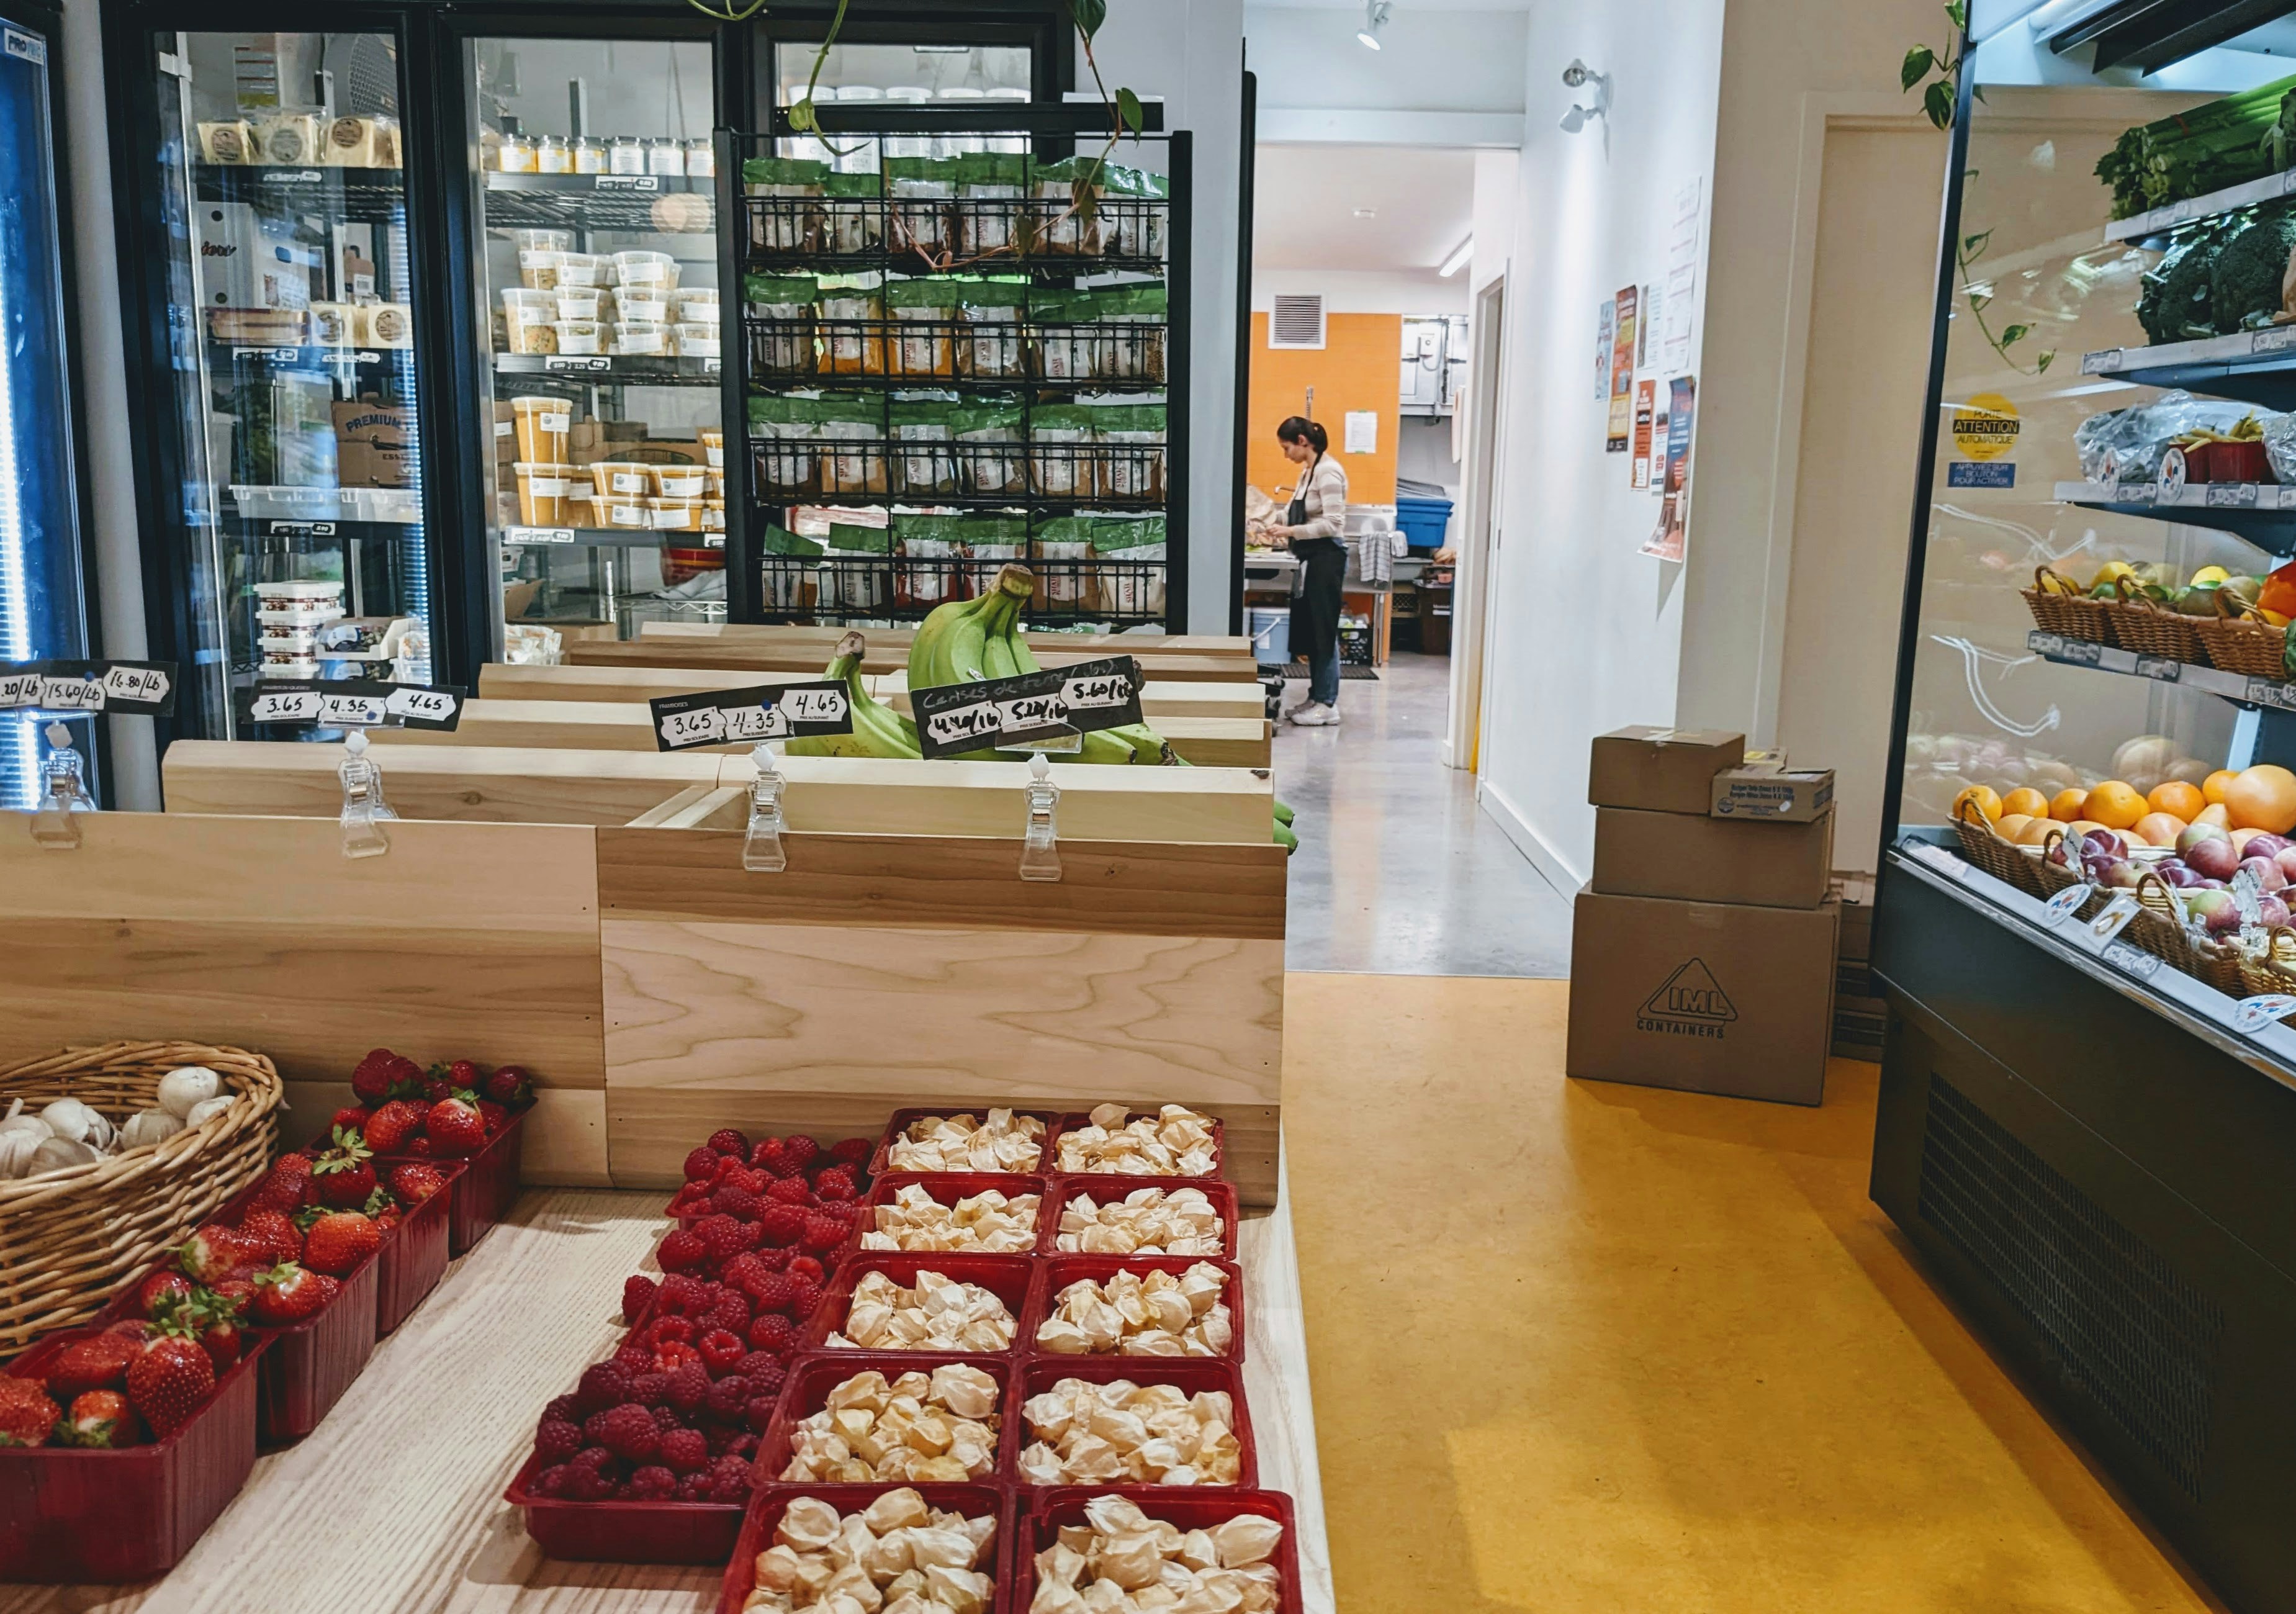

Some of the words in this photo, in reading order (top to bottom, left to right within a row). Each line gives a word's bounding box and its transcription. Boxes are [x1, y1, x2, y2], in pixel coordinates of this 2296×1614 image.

[346, 414, 400, 432] PREMIUM
[1955, 421, 2017, 433] ATTENTION
[1957, 435, 2013, 444] AUTOMATIQUE
[267, 697, 303, 713] 3.65
[330, 699, 369, 713] 4.35
[408, 694, 443, 710] 4.65
[796, 694, 838, 715] 4.65
[674, 713, 712, 735] 3.65
[733, 711, 775, 734] 4.35
[1668, 986, 1728, 1016] IML
[1637, 1019, 1724, 1039] CONTAINERS
